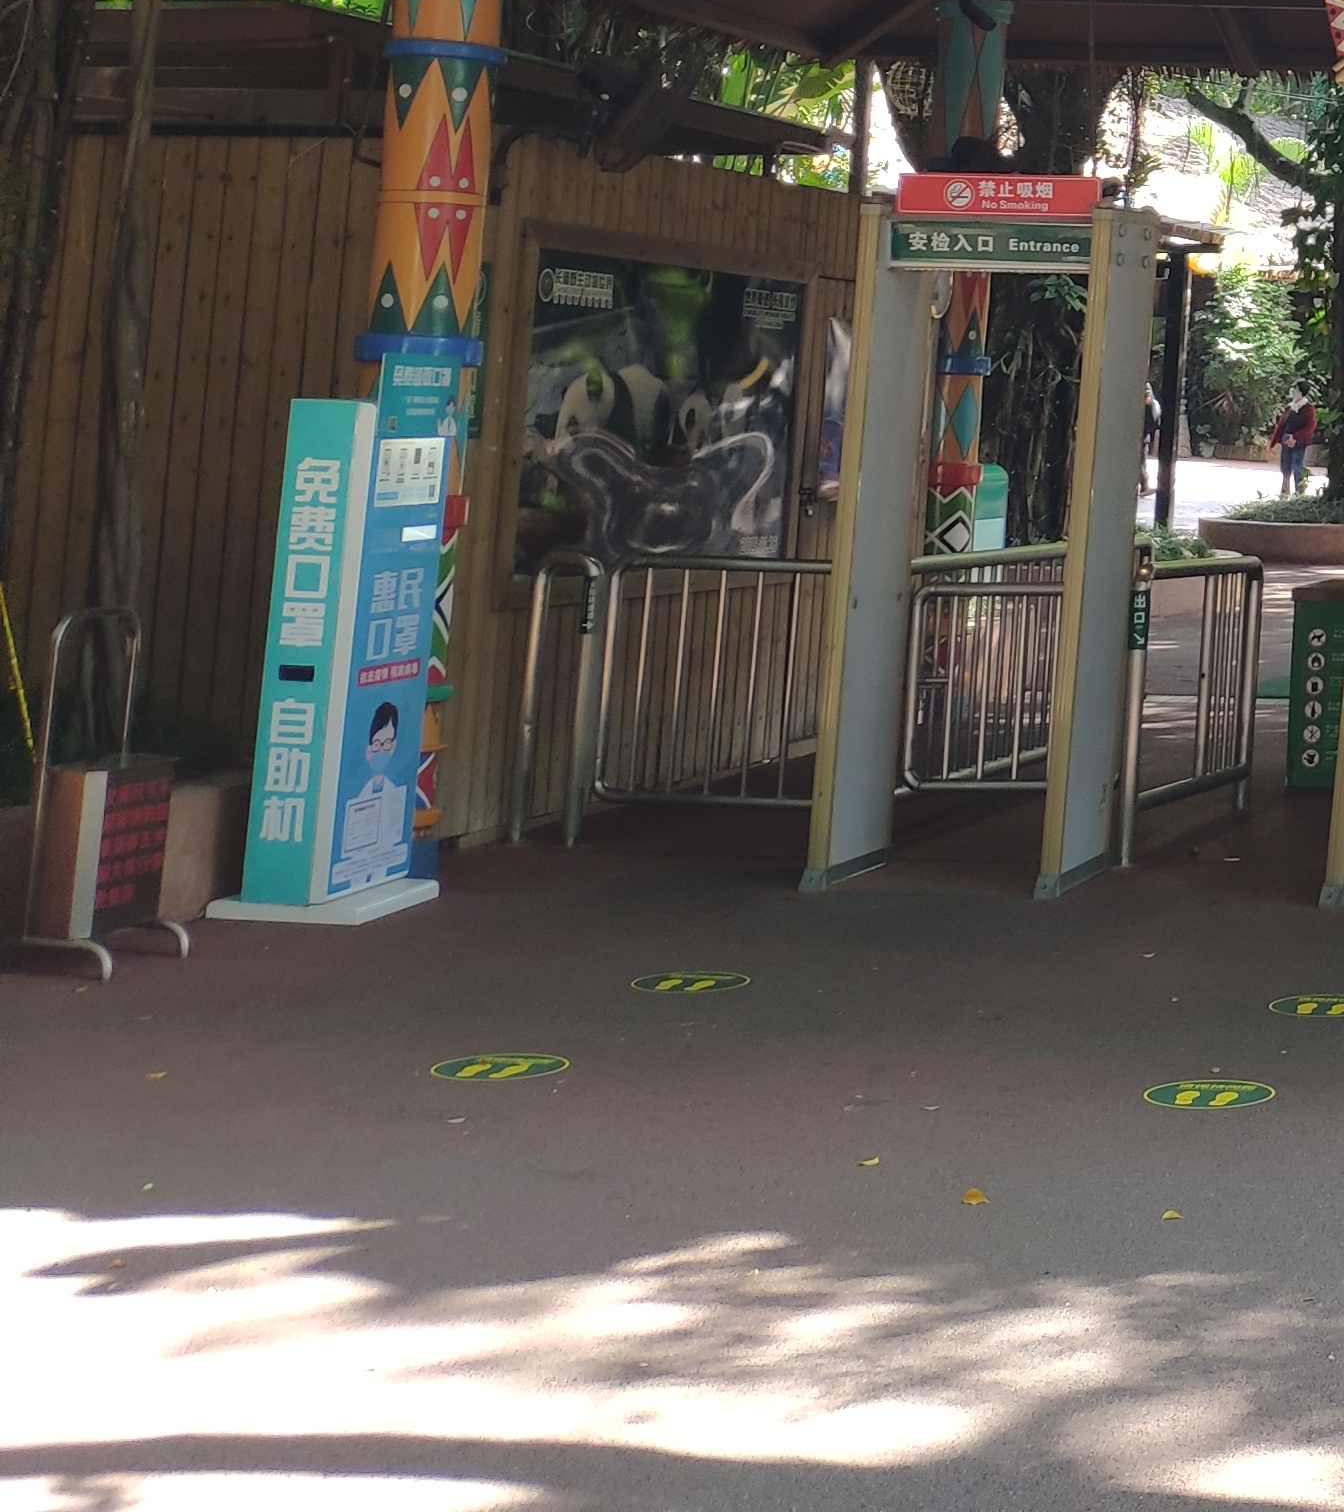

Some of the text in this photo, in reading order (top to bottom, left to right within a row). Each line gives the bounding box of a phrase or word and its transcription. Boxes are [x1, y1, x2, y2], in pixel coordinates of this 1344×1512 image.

[979, 181, 1053, 199] 禁止吸烟
[982, 200, 1049, 211] No Smoking
[909, 232, 1080, 253] 安检入口 Entrance
[279, 456, 341, 648] 免费口罩
[370, 567, 424, 614] 惠民
[1133, 592, 1147, 624] 出口
[365, 613, 420, 661] 口罩
[259, 698, 315, 844] 自助机
